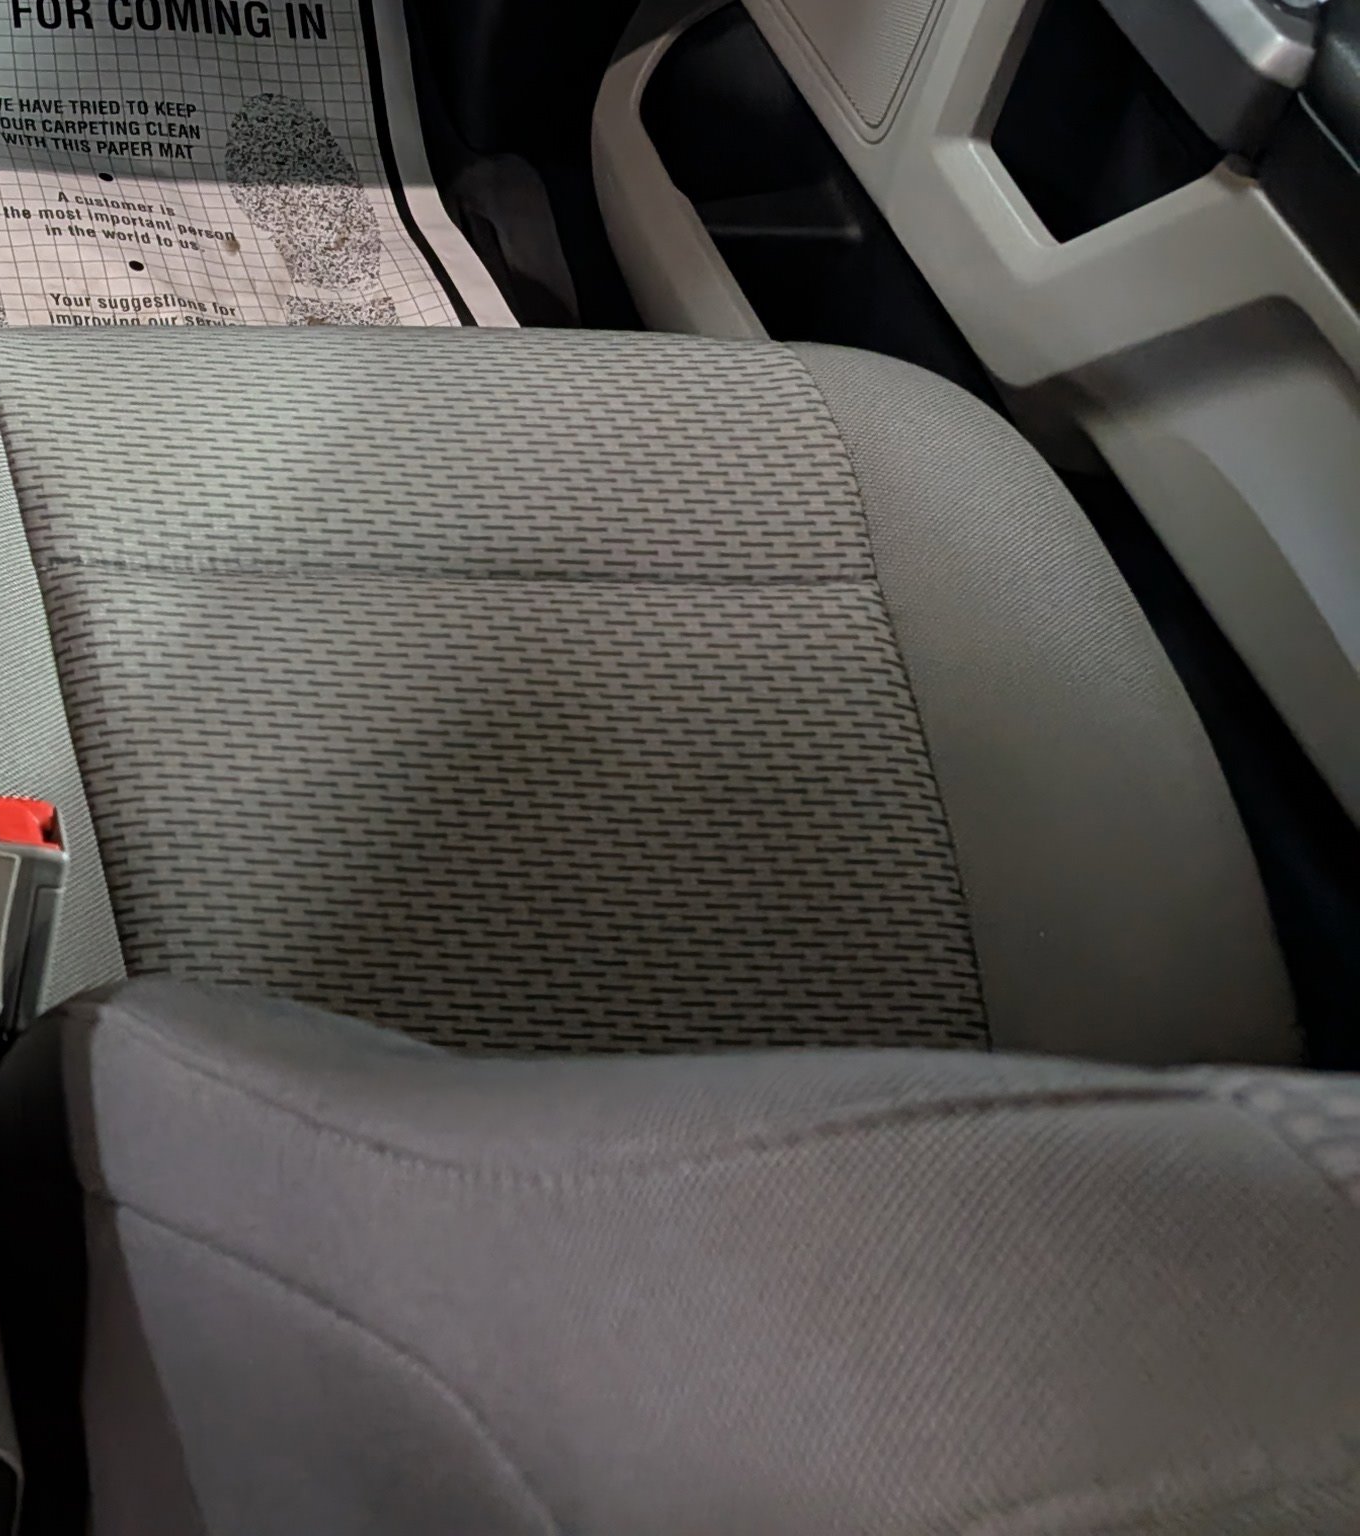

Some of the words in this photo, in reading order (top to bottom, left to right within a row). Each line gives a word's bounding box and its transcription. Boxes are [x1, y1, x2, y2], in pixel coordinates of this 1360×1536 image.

[285, 2, 328, 40] IN
[19, 98, 63, 114] HAVE
[68, 99, 121, 115] TRIED
[126, 101, 149, 115] TO
[154, 101, 197, 118] KEEP
[42, 120, 140, 136] CARPETING
[146, 121, 200, 140] CLEAN
[1, 132, 47, 148] WITH
[51, 137, 91, 154] THIS
[97, 140, 153, 157] PAPER
[159, 142, 194, 160] MAT
[57, 191, 69, 203] A
[75, 194, 154, 214] customer
[160, 203, 176, 217] is
[3, 206, 31, 219] the
[38, 207, 81, 221] most
[88, 208, 172, 232] important
[177, 223, 235, 242] person
[45, 224, 63, 237] in
[68, 224, 97, 238] the
[102, 227, 151, 245] world
[156, 234, 173, 248] to
[179, 240, 206, 253] us.
[49, 293, 92, 308] Your
[97, 293, 207, 312] suggestions
[212, 301, 237, 317] for
